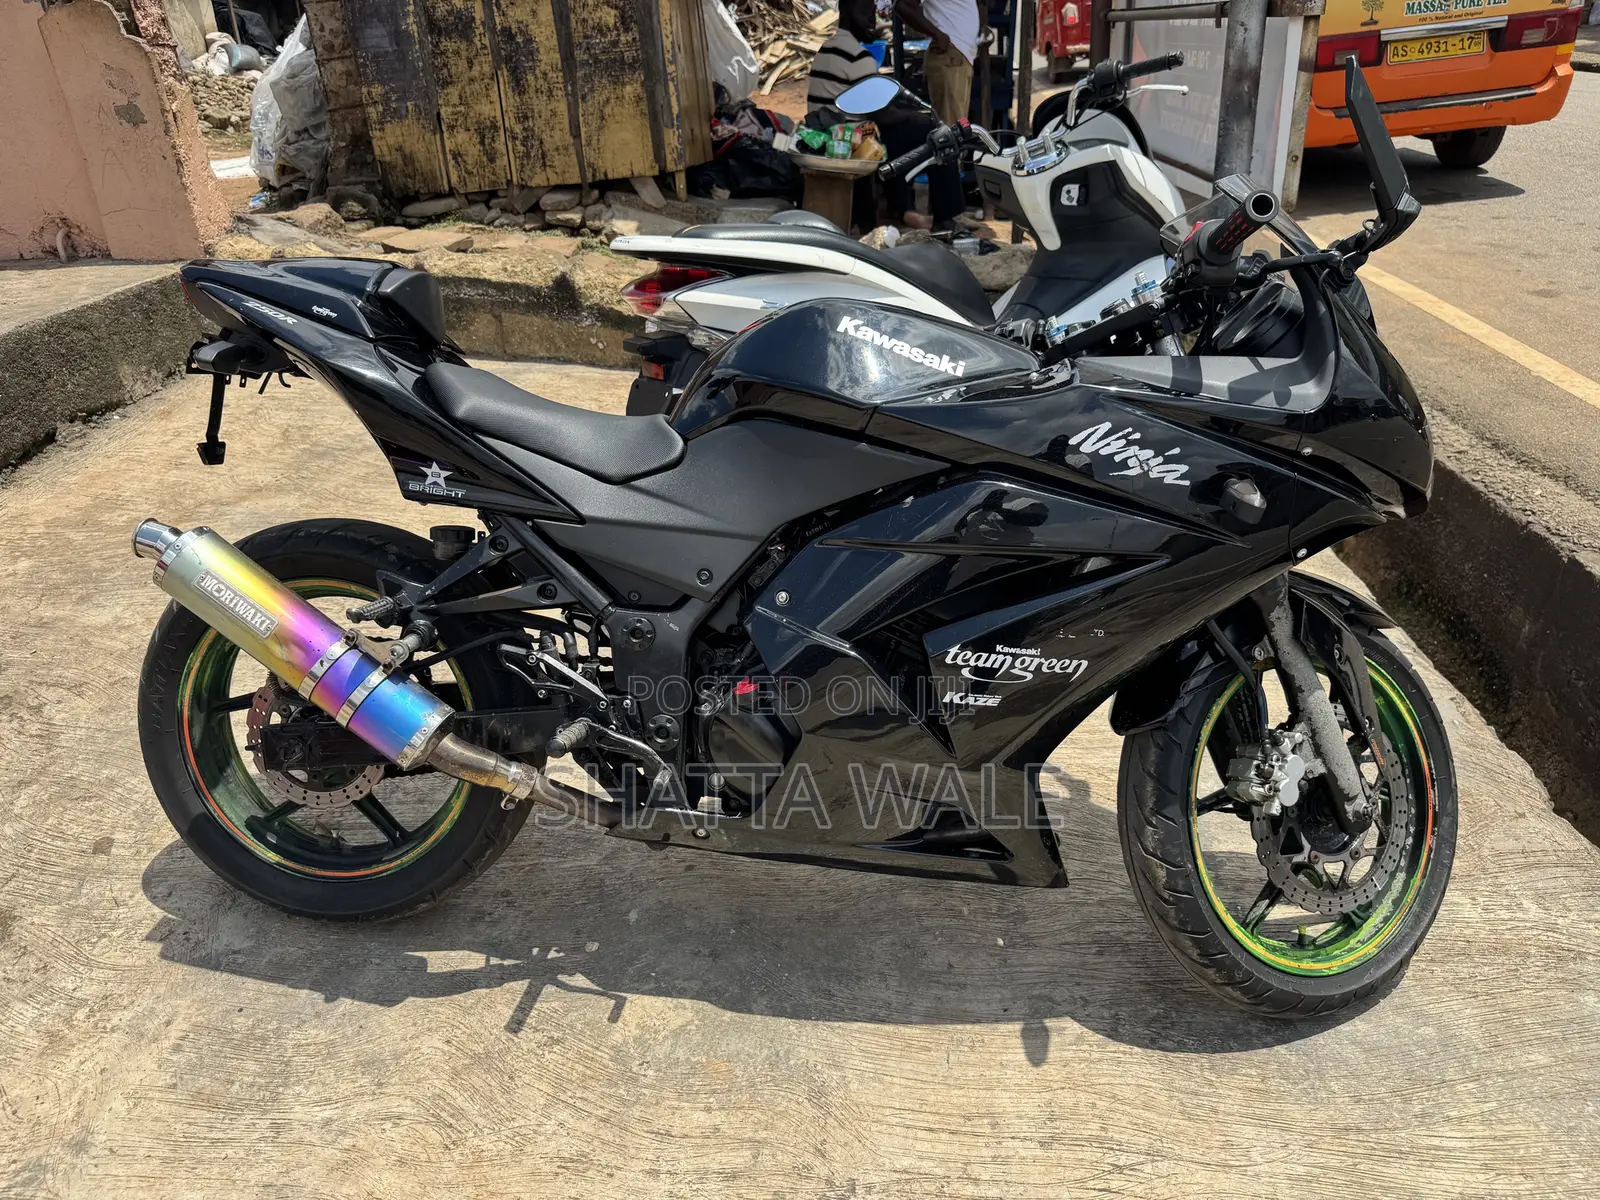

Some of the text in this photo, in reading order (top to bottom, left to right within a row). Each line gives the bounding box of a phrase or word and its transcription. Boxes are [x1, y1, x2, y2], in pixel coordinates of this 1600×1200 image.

[1392, 45, 1408, 58] AS
[836, 316, 966, 377] Kawasaki
[1068, 421, 1191, 486] Ninja
[201, 575, 272, 633] MORIWAKI
[944, 644, 1089, 683] team green
[995, 644, 1041, 656] Kawasaki
[942, 691, 1002, 707] KAZE
